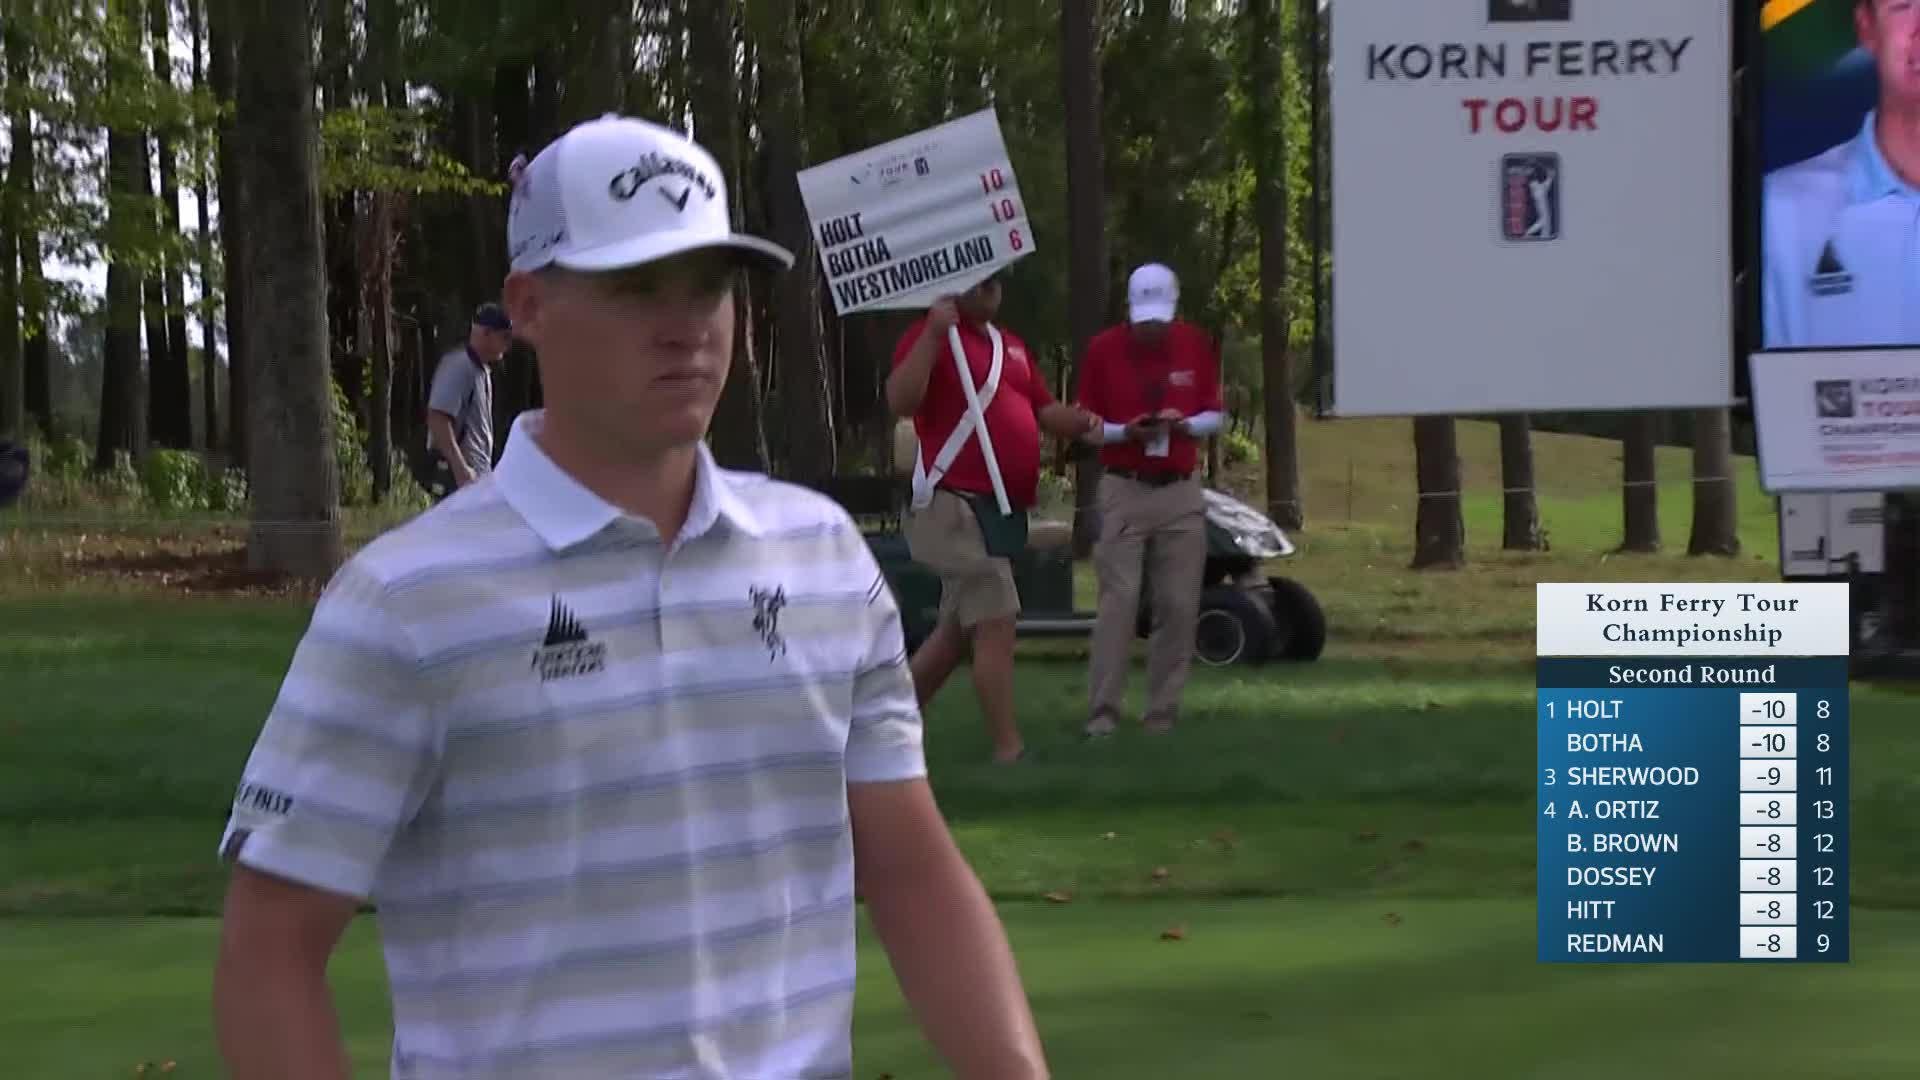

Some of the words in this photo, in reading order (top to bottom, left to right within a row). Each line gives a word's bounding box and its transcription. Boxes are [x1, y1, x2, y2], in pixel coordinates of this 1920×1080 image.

[1367, 43, 1506, 81] KORN
[1526, 37, 1693, 77] FERRY
[1461, 97, 1598, 134] TOUR
[819, 212, 864, 248] HOLT
[980, 168, 1004, 193] 10
[827, 236, 891, 278] BOTHA
[990, 199, 1015, 223] 10
[836, 234, 994, 309] WESTMORELAND
[1008, 229, 1023, 252] 6
